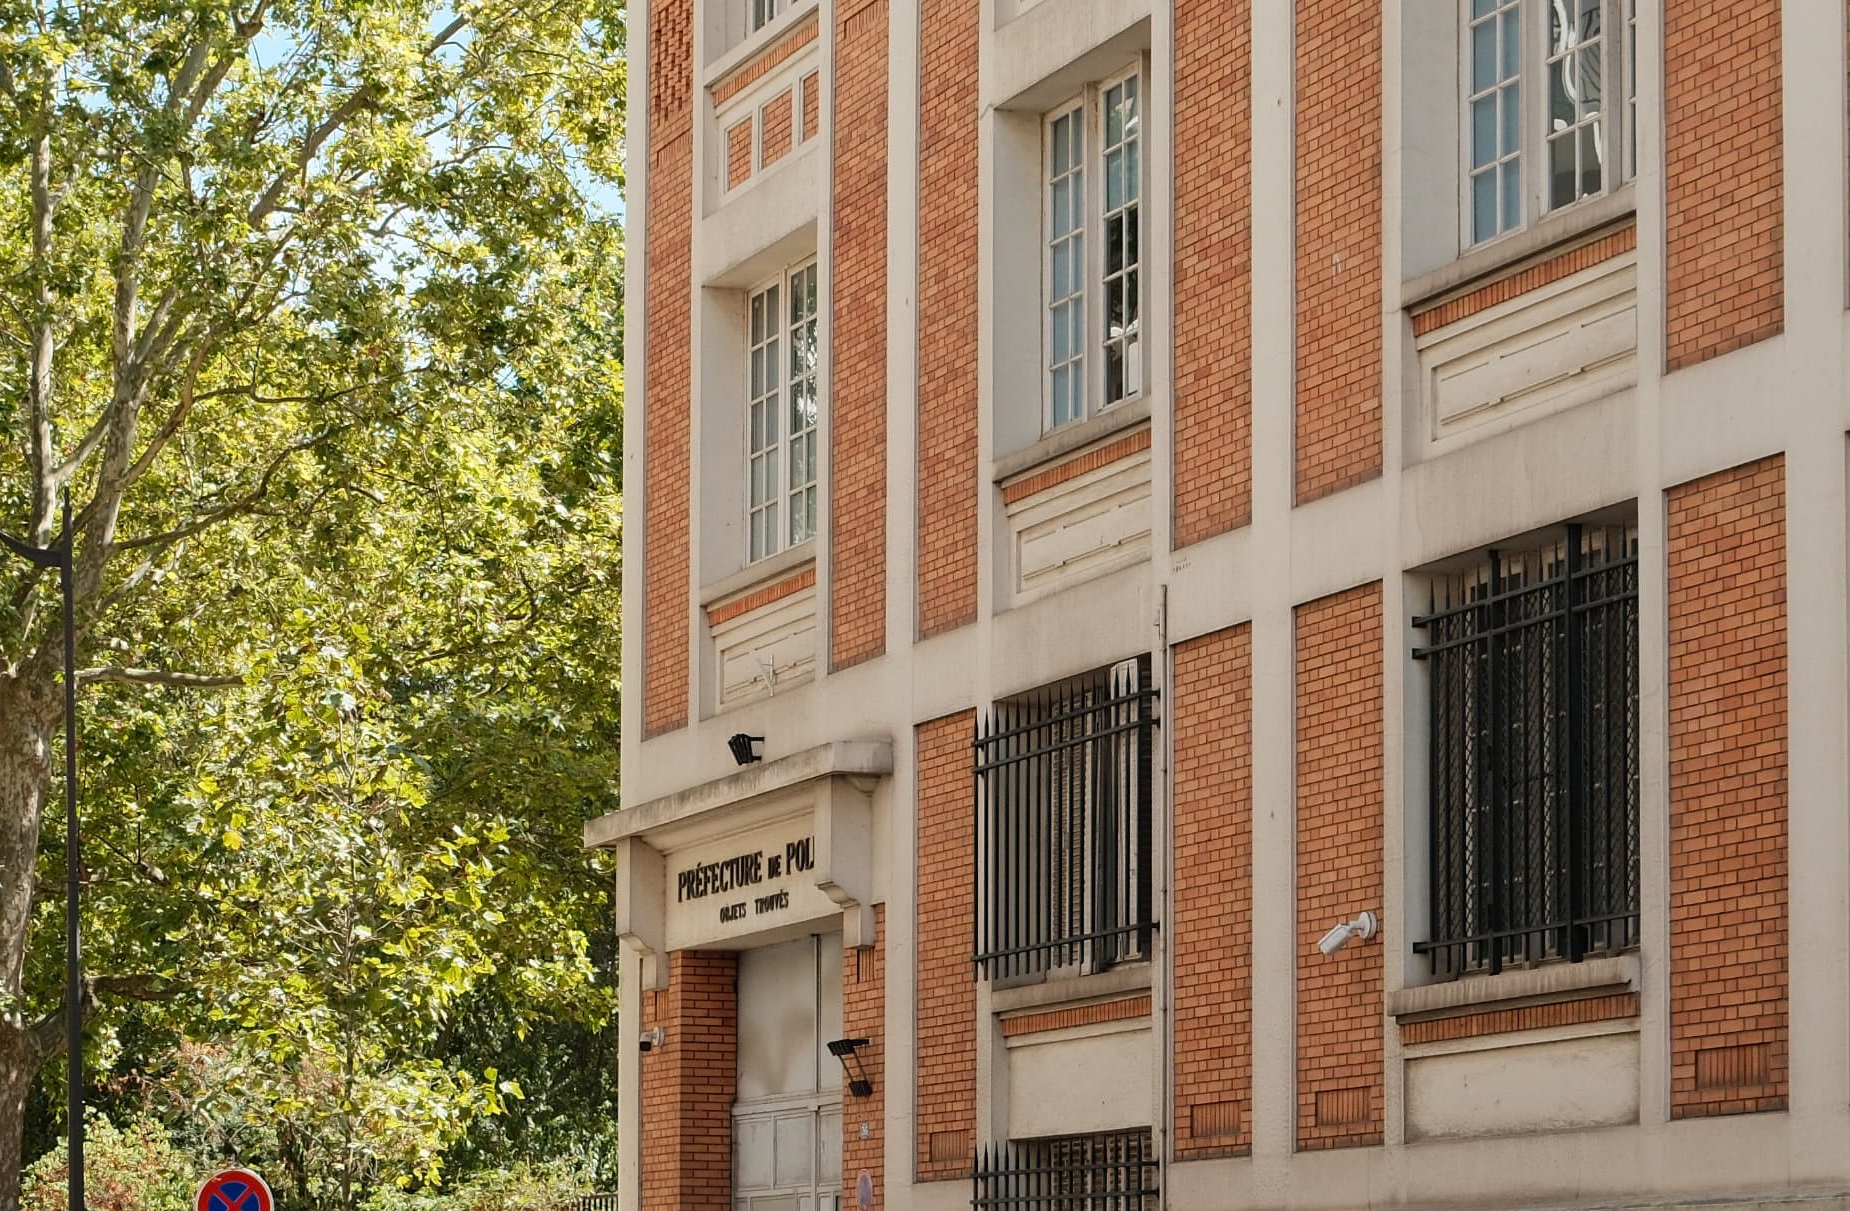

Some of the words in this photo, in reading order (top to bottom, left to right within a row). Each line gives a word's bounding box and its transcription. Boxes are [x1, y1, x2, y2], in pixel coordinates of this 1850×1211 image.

[677, 850, 763, 903] PRÉFECTURE
[767, 854, 782, 880] DE
[785, 836, 814, 876] POL
[719, 902, 747, 923] OBJETS
